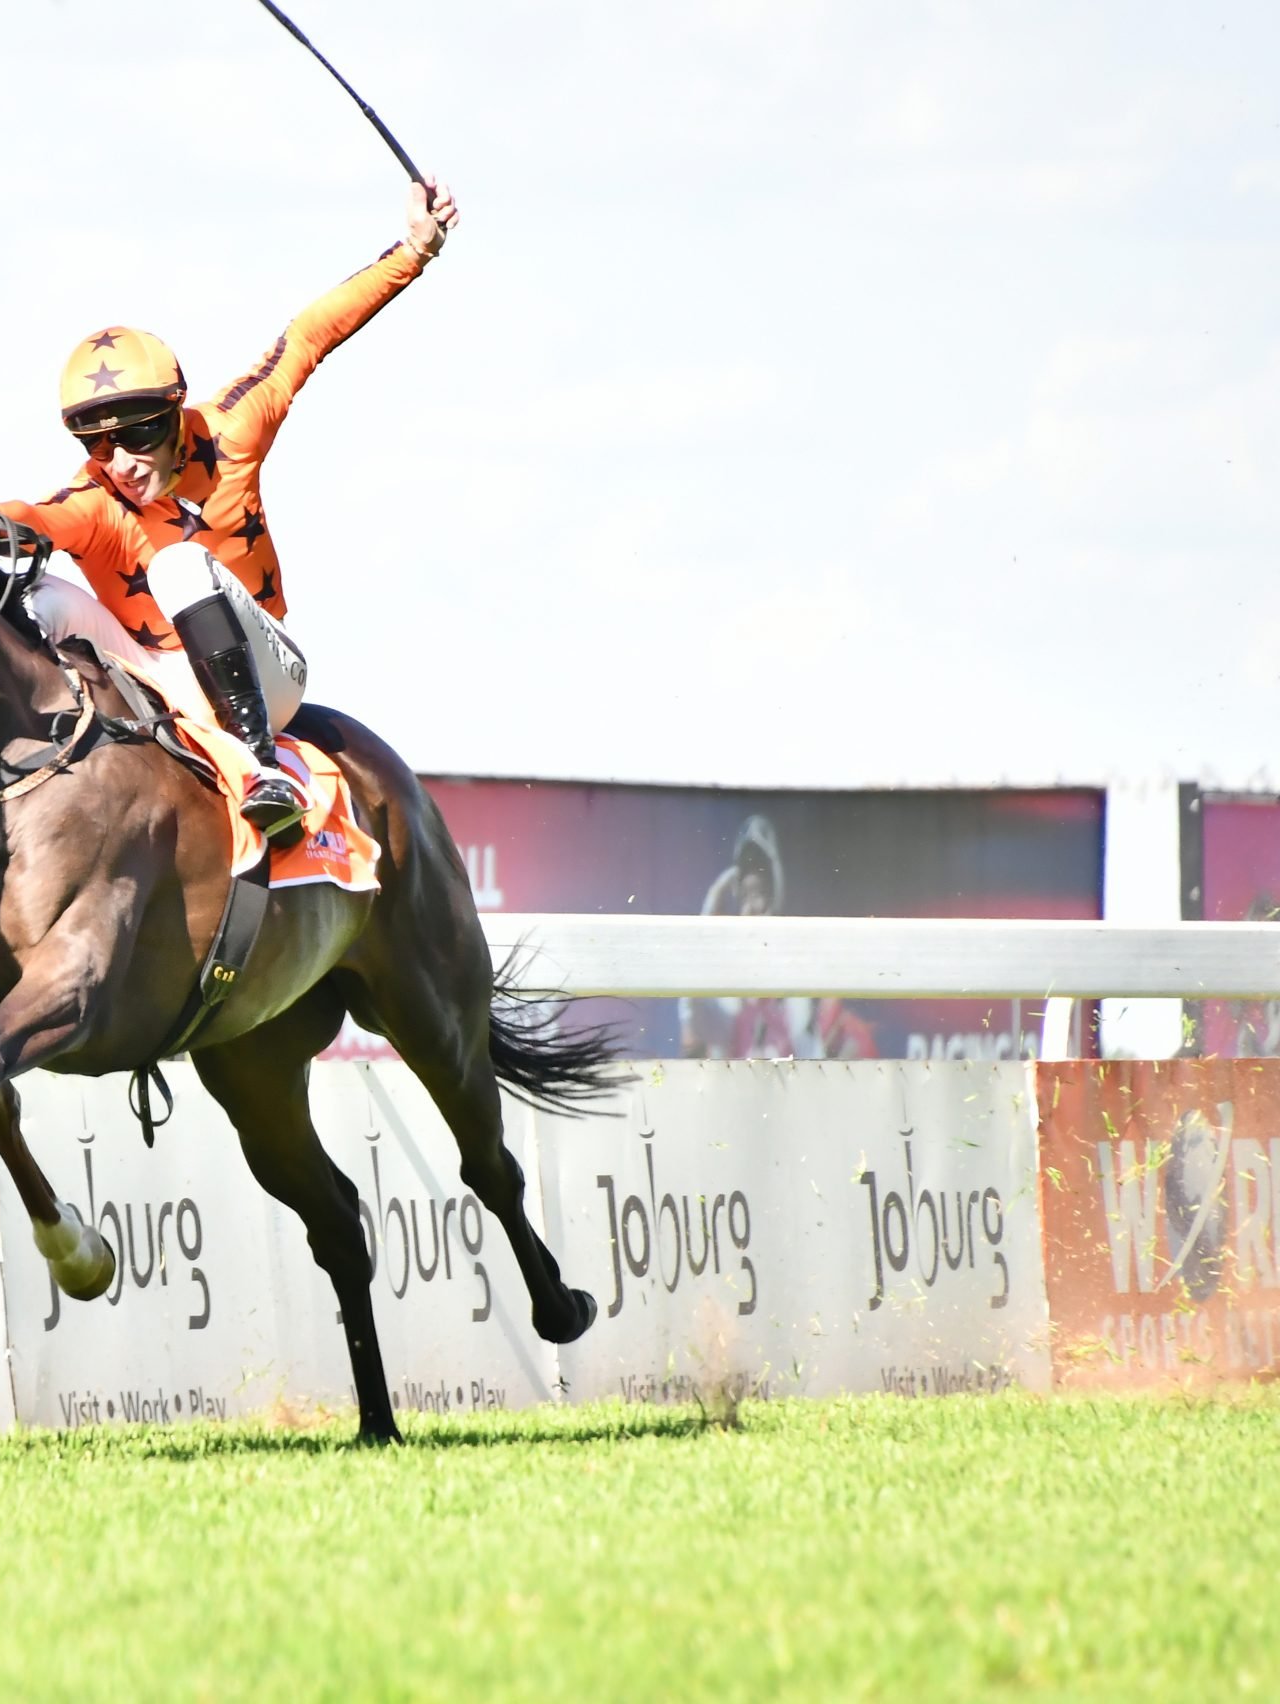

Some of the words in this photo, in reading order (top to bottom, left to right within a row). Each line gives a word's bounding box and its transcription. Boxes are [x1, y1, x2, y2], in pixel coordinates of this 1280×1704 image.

[44, 1147, 212, 1331] Jburg
[597, 1143, 758, 1318] Joburg
[860, 1140, 1010, 1311] Joburg
[58, 1390, 102, 1427] Visit
[120, 1388, 172, 1425] Work
[404, 1379, 451, 1415] Work
